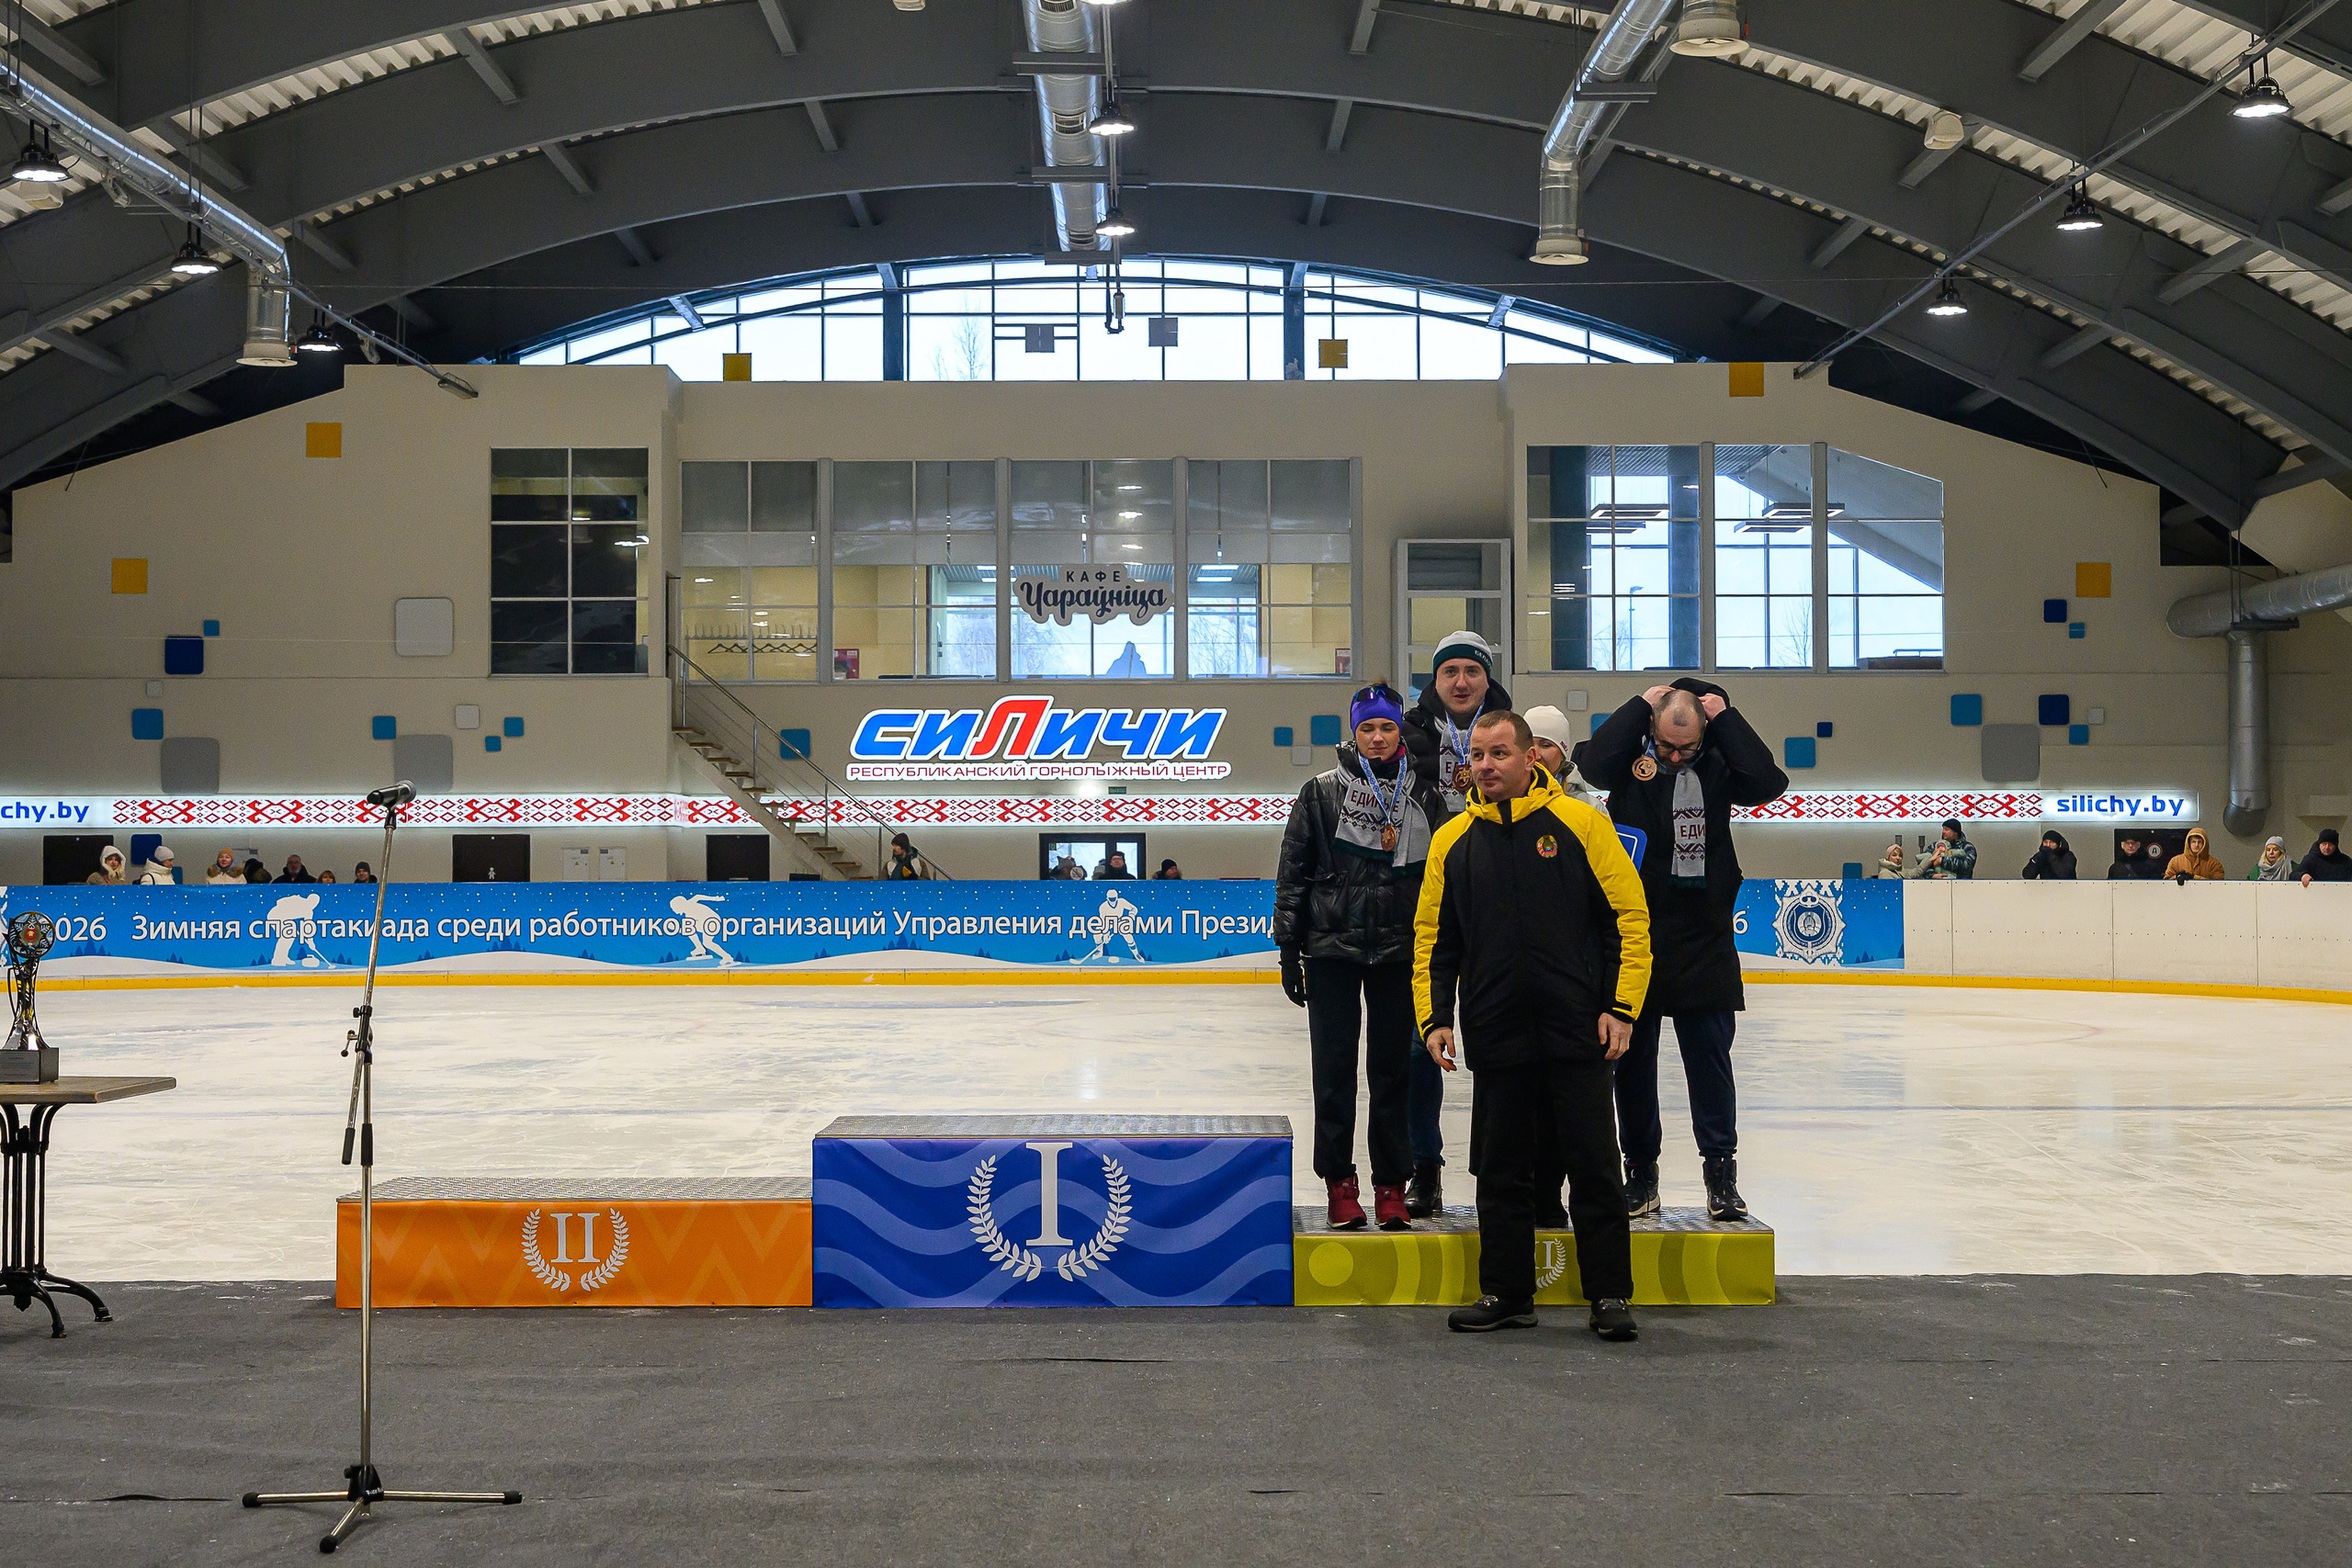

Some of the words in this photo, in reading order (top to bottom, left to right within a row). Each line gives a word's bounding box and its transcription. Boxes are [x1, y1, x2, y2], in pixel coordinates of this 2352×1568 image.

[1066, 570, 1121, 582] КАФЕ
[1020, 581, 1168, 619] Чараўніца
[850, 764, 1025, 777] РЕСПУБЛИКАНСКИЙ
[1030, 763, 1168, 776] ГОРНОЛЫЖНЫЙ
[1173, 765, 1227, 779] ЦЕНТР
[2057, 795, 2185, 816] silichy.by
[55, 917, 107, 942] 026
[131, 915, 240, 940] Зимняя
[248, 919, 429, 943] спартакиада
[437, 918, 521, 942] среди
[529, 911, 696, 942] работников
[702, 911, 886, 942] организаций
[892, 910, 1062, 941] Управления
[1069, 915, 1173, 940] делами
[1026, 1142, 1073, 1247] I
[550, 1213, 601, 1263] II
